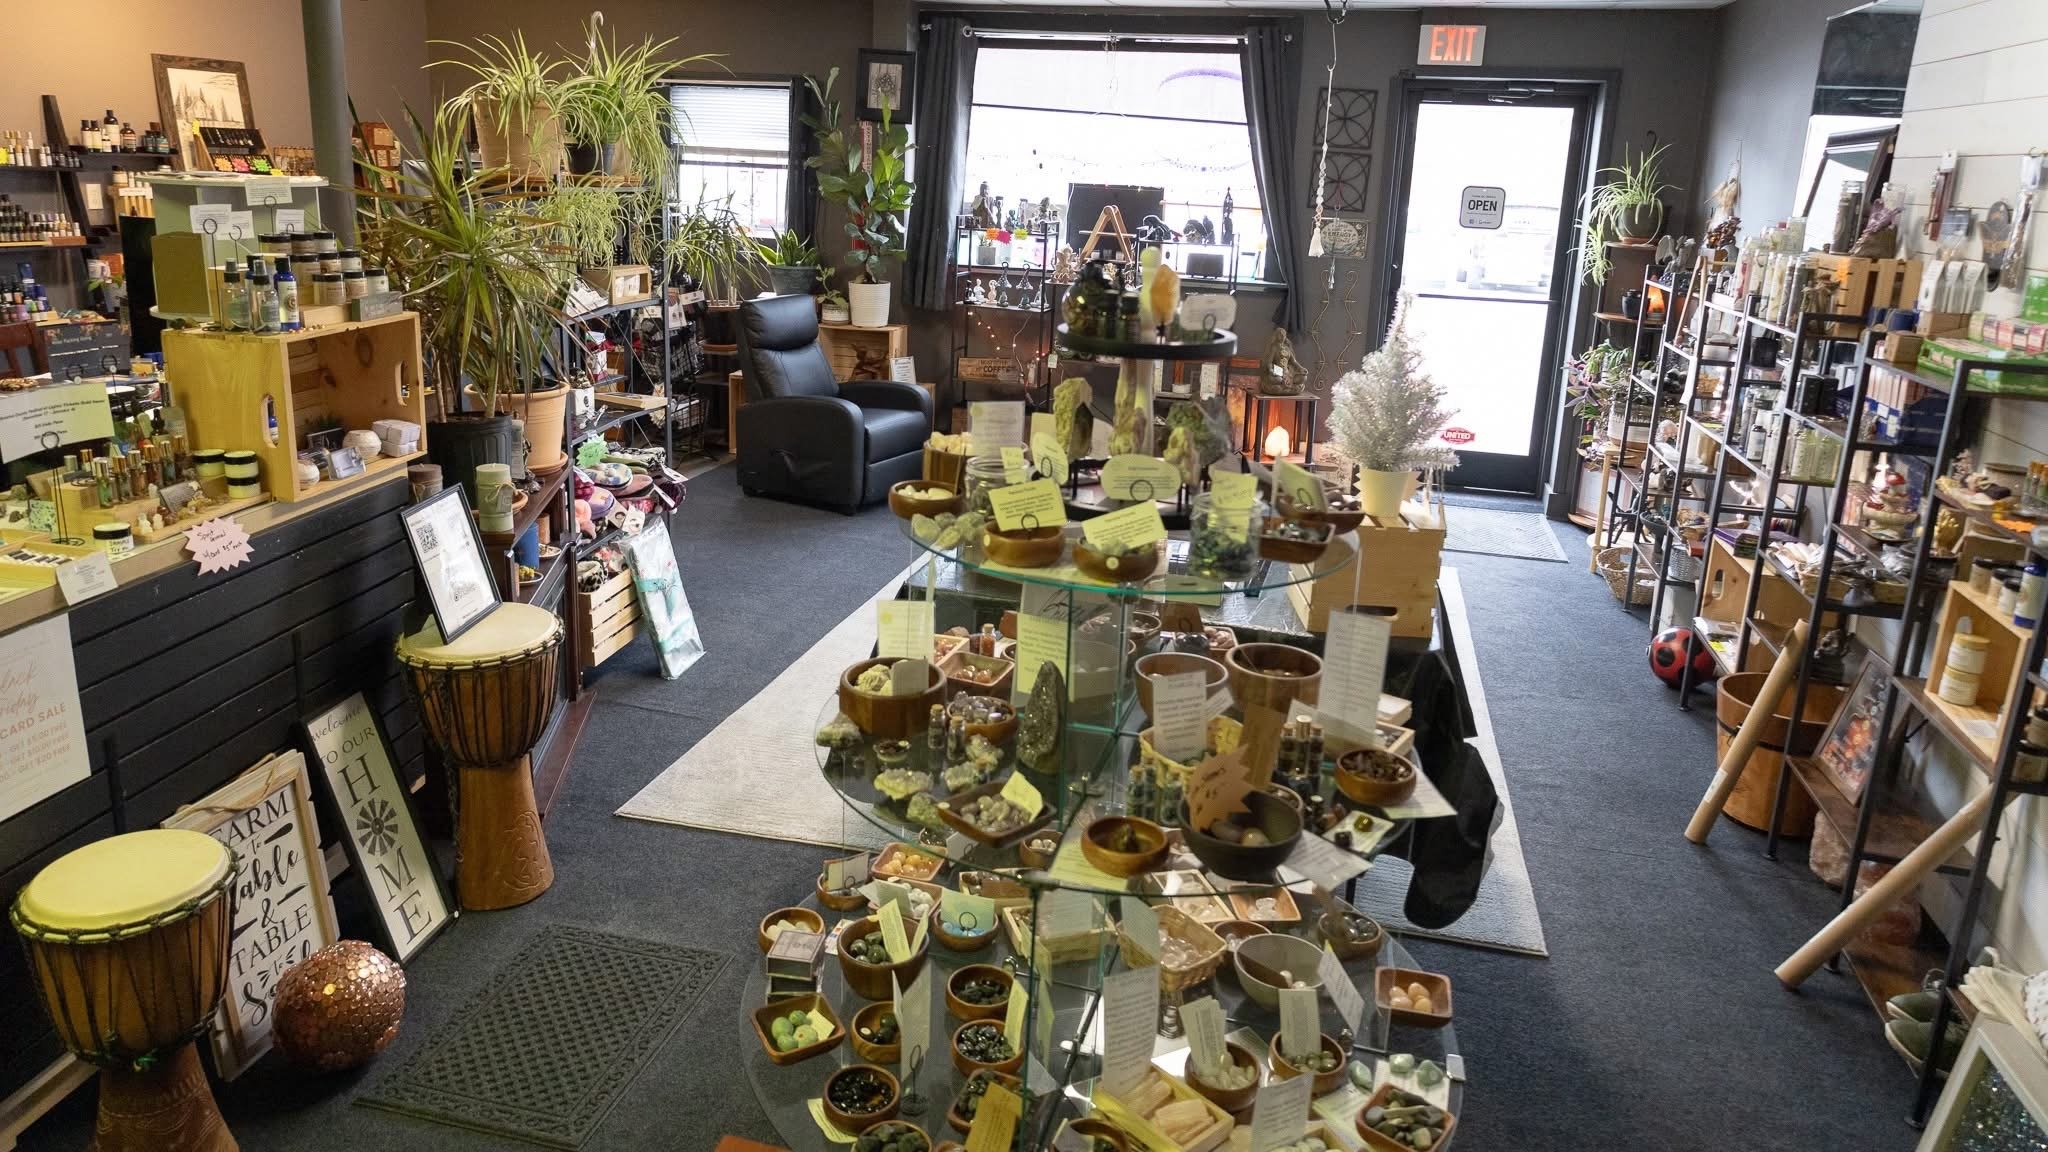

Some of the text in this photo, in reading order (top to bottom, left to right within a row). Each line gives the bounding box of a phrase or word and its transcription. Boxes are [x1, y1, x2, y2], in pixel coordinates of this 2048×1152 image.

[1430, 26, 1478, 62] EXIT
[1468, 199, 1498, 212] OPEN
[1443, 430, 1471, 440] UNITED
[0, 701, 67, 740] CARD SALE
[311, 704, 364, 742] welcome
[319, 726, 375, 769] TO OUR
[230, 903, 312, 978] TABLE
